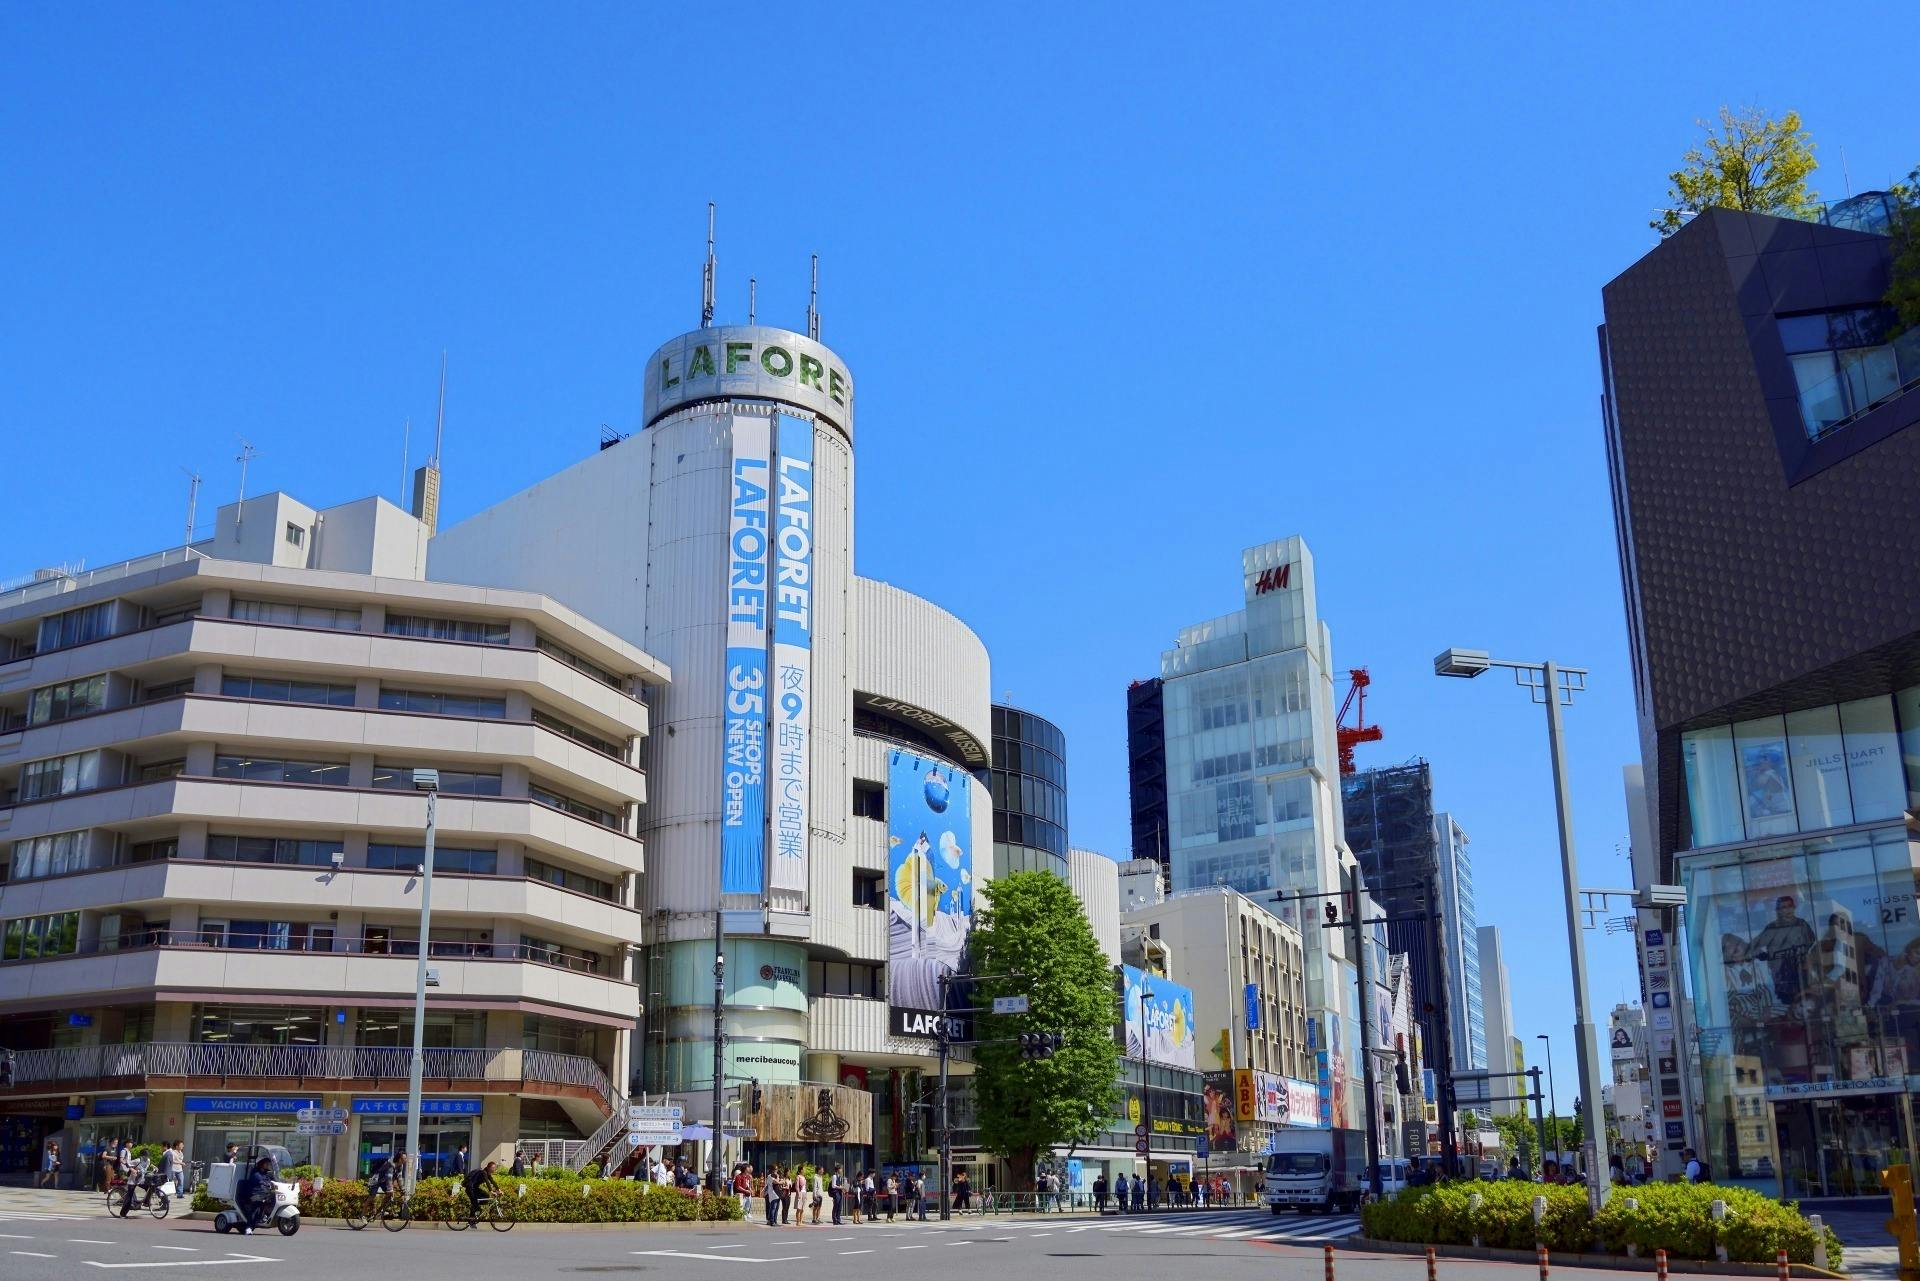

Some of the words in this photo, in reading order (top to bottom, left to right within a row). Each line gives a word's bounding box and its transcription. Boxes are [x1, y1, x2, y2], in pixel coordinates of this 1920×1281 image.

[662, 342, 850, 408] LAFORE
[731, 458, 767, 631] LAFORET
[778, 455, 810, 631] LAFORET
[1255, 564, 1290, 595] H&M
[727, 664, 764, 715] 35
[865, 696, 953, 728] LAFORET
[727, 718, 745, 767] NEW
[744, 719, 762, 785] SHOPS
[778, 664, 805, 859] 夜9時まで営業
[725, 771, 744, 826] OPEN
[1882, 907, 1907, 924] 2F
[210, 1100, 259, 1110] YACHIYO
[264, 1100, 296, 1110] BANK
[1198, 1136, 1206, 1145] P
[1409, 1129, 1421, 1157] FORE
[1169, 1164, 1177, 1174] P
